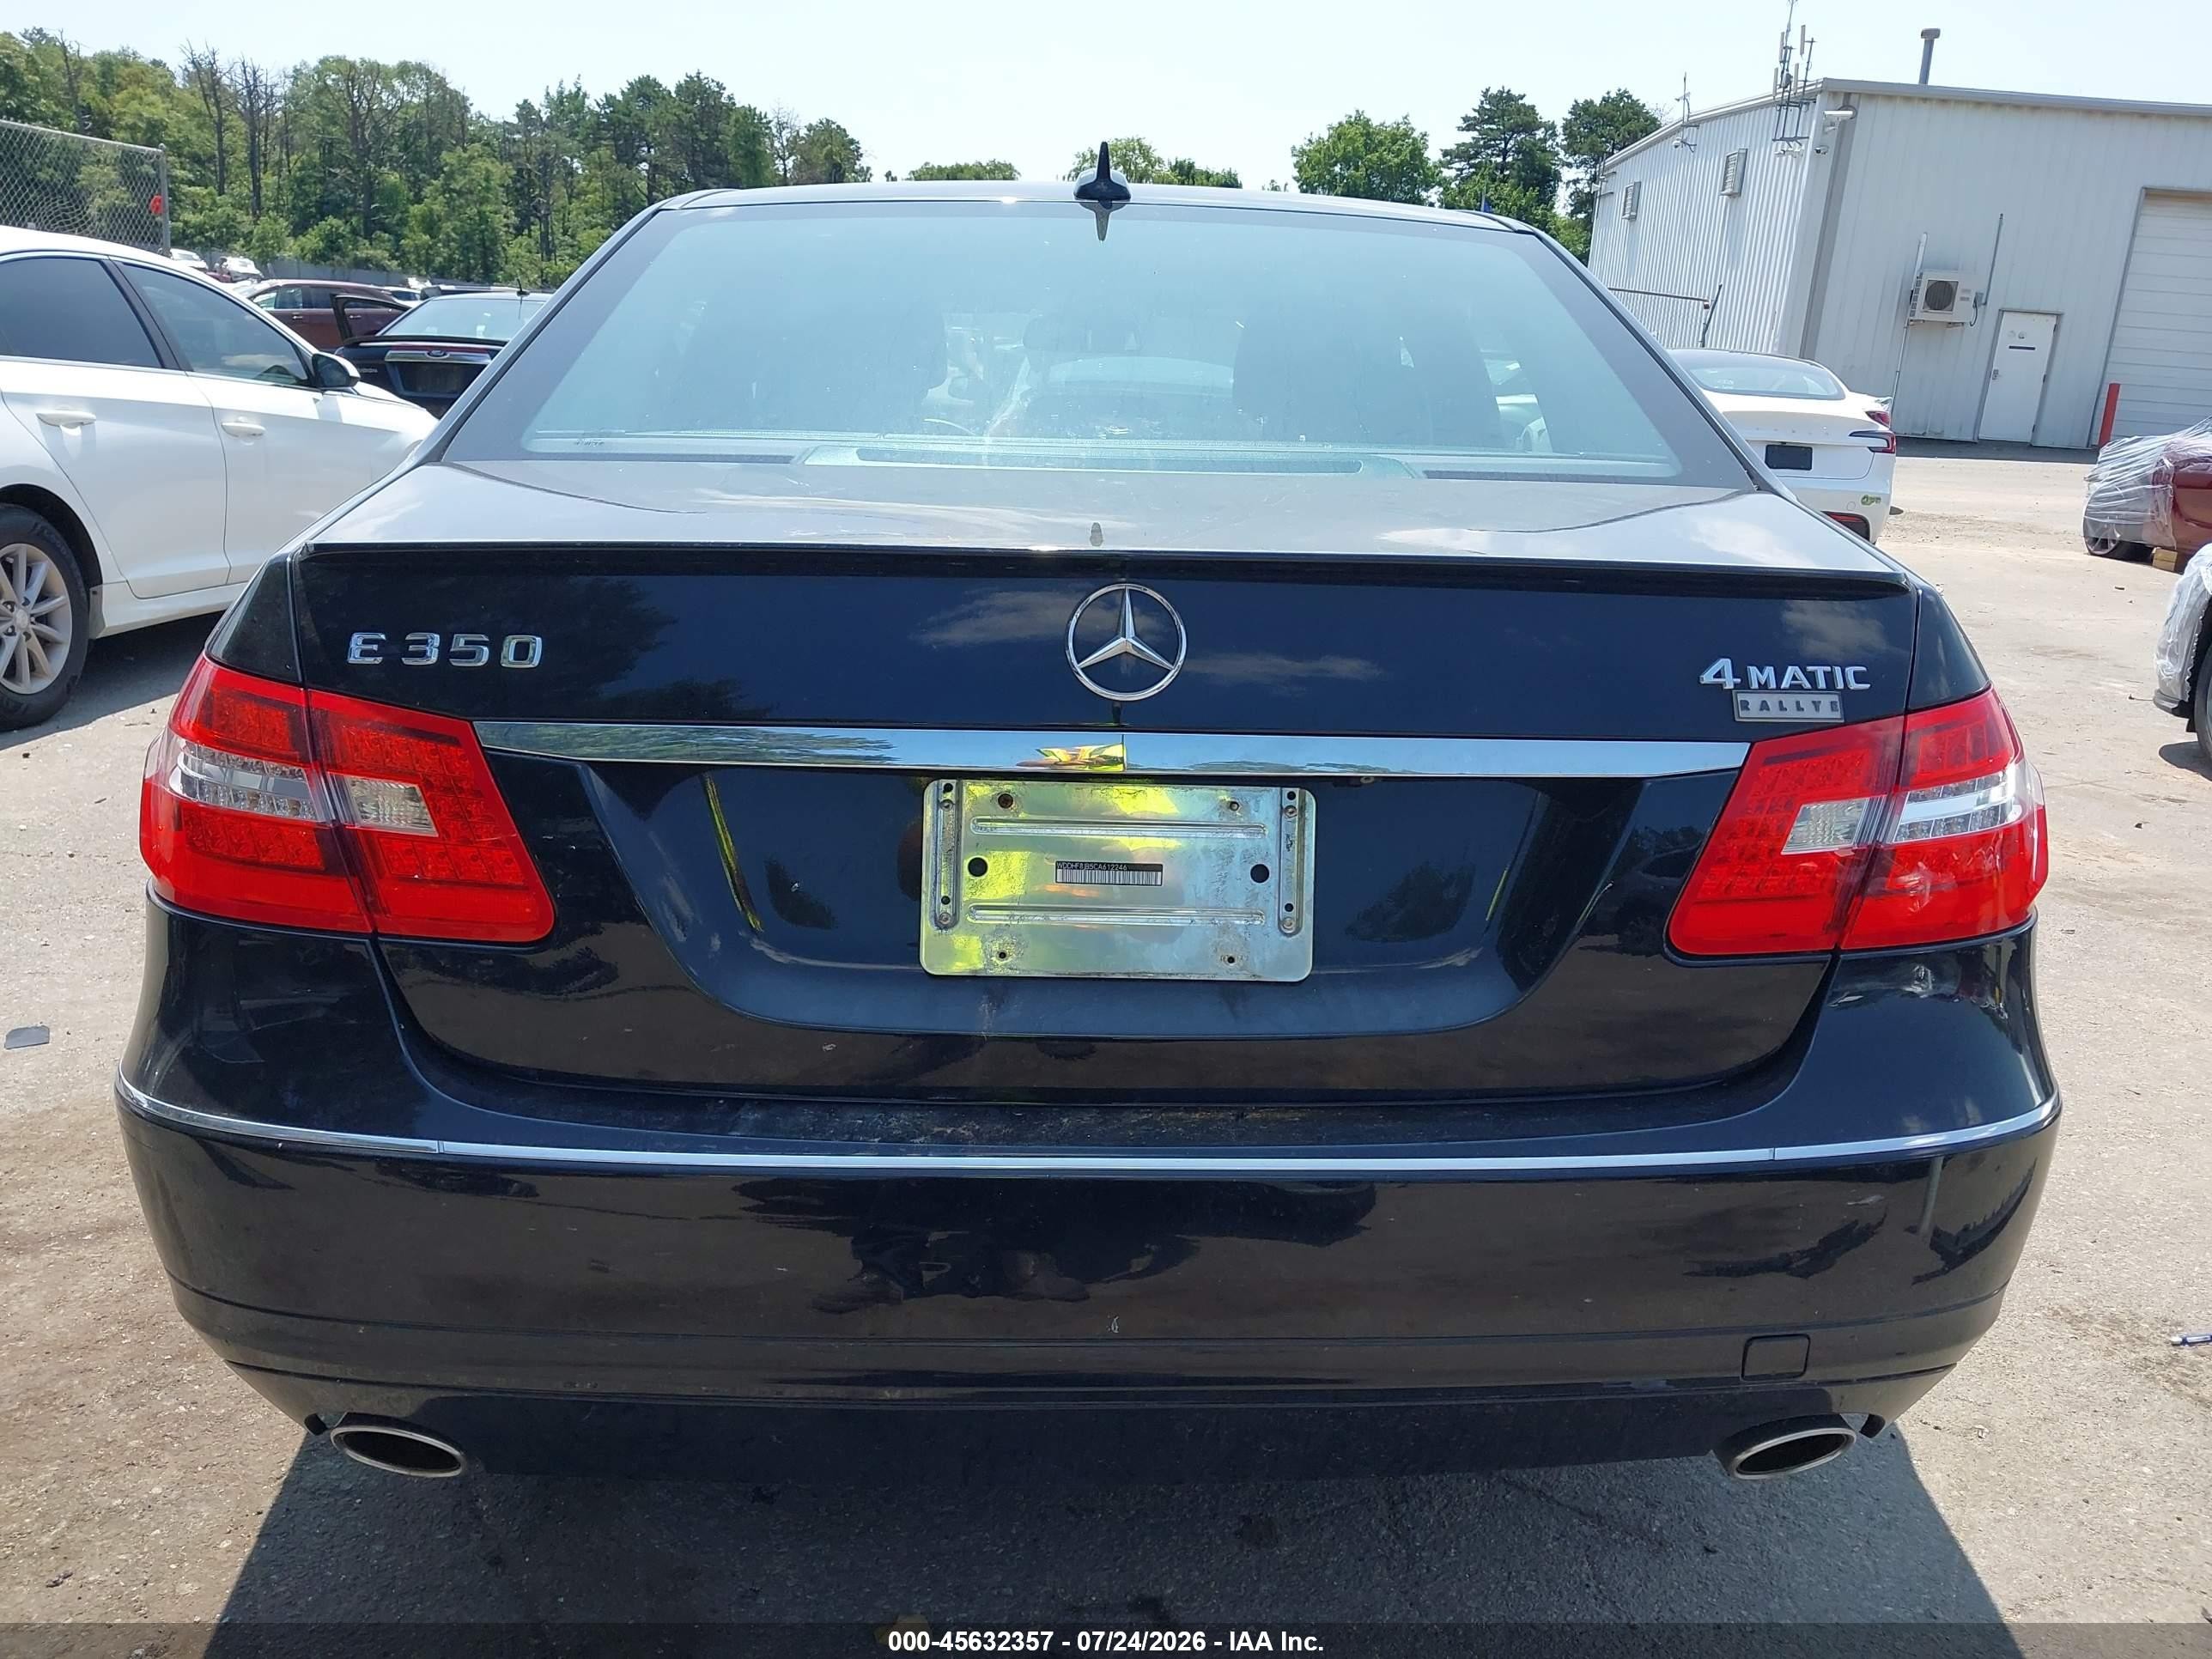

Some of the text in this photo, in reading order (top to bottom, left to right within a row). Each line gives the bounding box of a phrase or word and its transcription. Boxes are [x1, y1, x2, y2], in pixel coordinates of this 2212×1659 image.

[347, 632, 543, 669] E 350
[1698, 658, 1871, 690] 4 MATIC
[1739, 699, 1839, 714] RALLYE
